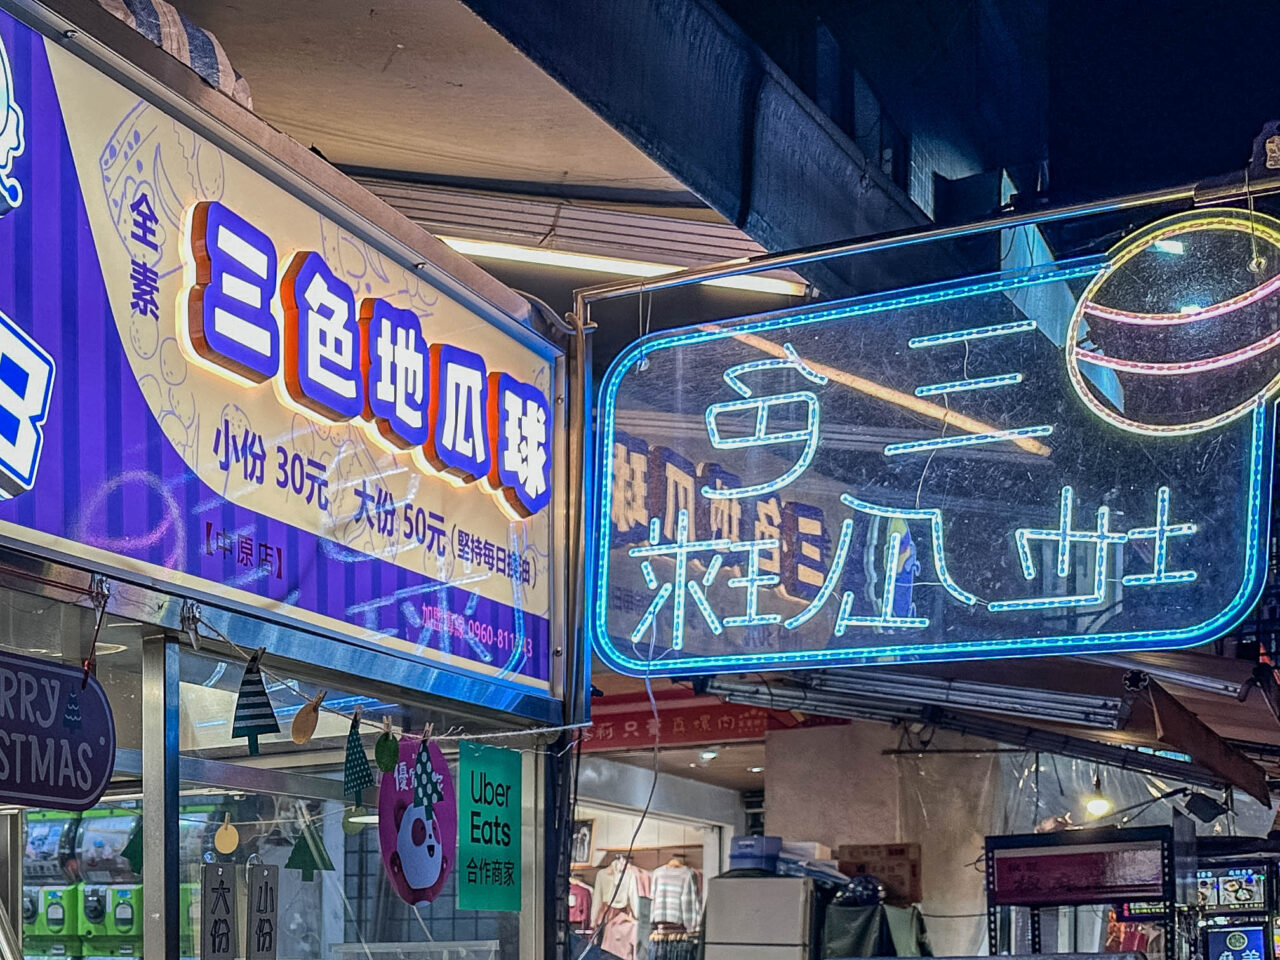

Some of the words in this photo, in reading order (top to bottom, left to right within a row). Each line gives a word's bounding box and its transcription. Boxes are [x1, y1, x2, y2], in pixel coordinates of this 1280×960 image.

[128, 192, 161, 322] 全素
[188, 205, 554, 518] 三色地瓜球
[213, 419, 267, 485] 小份
[276, 445, 329, 511] 30元
[353, 479, 395, 538] 大份
[403, 503, 447, 559] 50元
[470, 770, 512, 808] Uber
[470, 810, 511, 847] Eats
[466, 857, 515, 886] 合作商家
